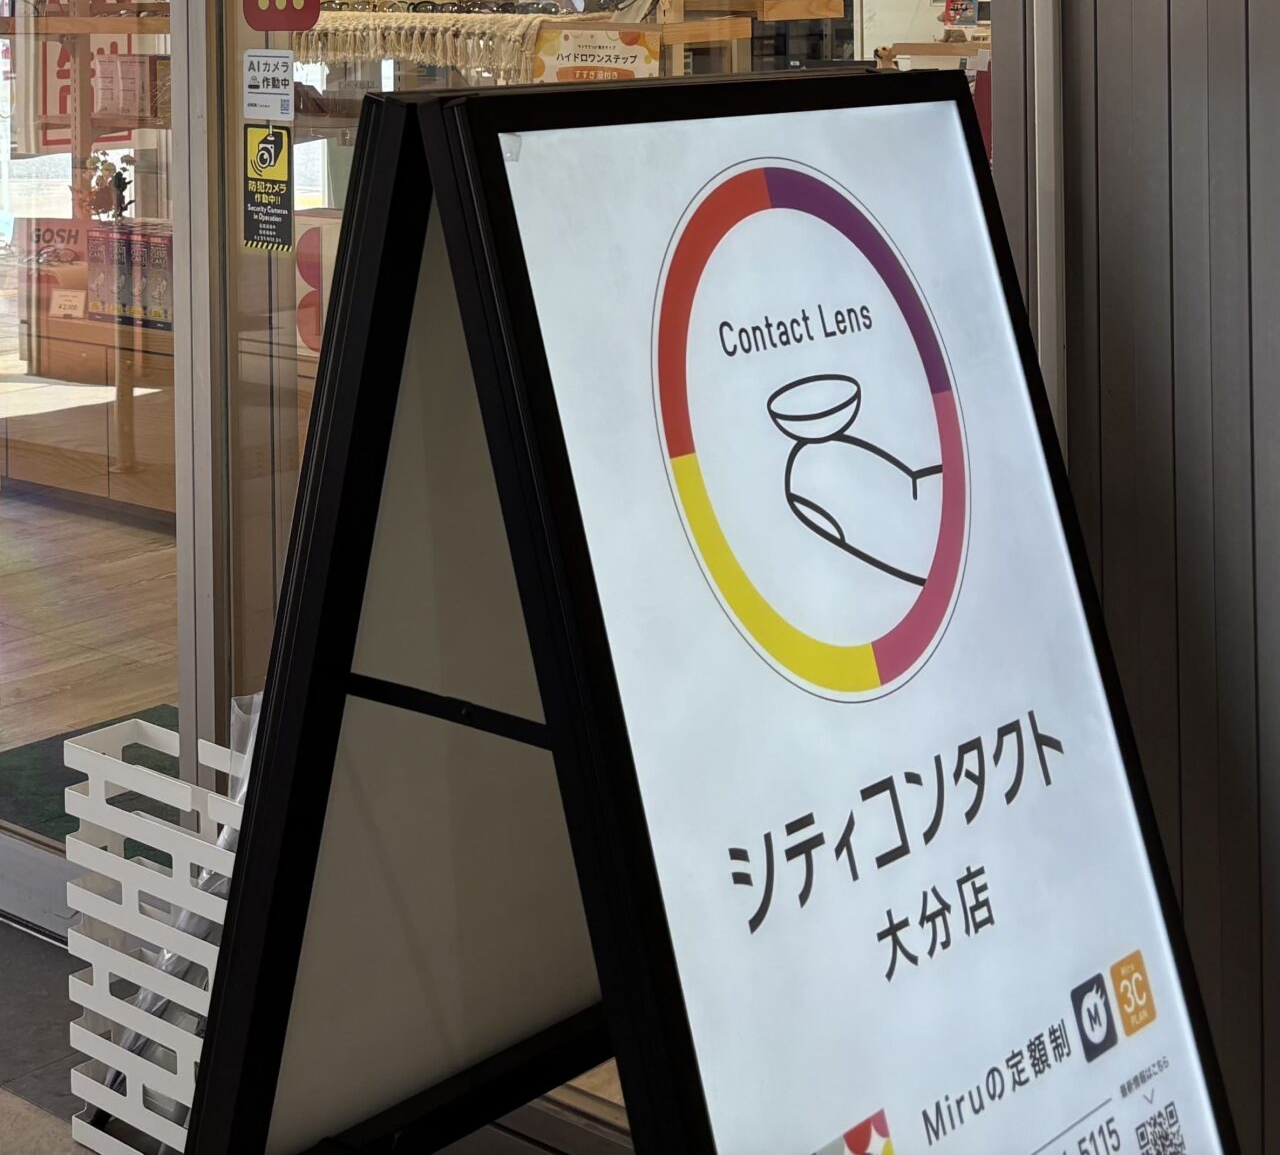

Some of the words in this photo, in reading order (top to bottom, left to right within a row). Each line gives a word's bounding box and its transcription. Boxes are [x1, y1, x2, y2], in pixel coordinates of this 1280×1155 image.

[248, 61, 290, 73] AIカメラ
[556, 53, 637, 64] ハイドロワンステップ
[262, 77, 290, 89] 作動中
[248, 181, 287, 194] 防犯カメラ
[247, 203, 266, 214] Security
[267, 205, 288, 215] Cameras
[32, 228, 79, 245] GOSH
[719, 309, 814, 357] Contact
[818, 304, 873, 339] Lens
[728, 710, 1065, 935] シティコンタクト
[876, 865, 995, 982] 大分店
[1119, 972, 1147, 1013] 3C
[1129, 1009, 1149, 1027] PLAN
[921, 1017, 1072, 1145] Miruの定額制
